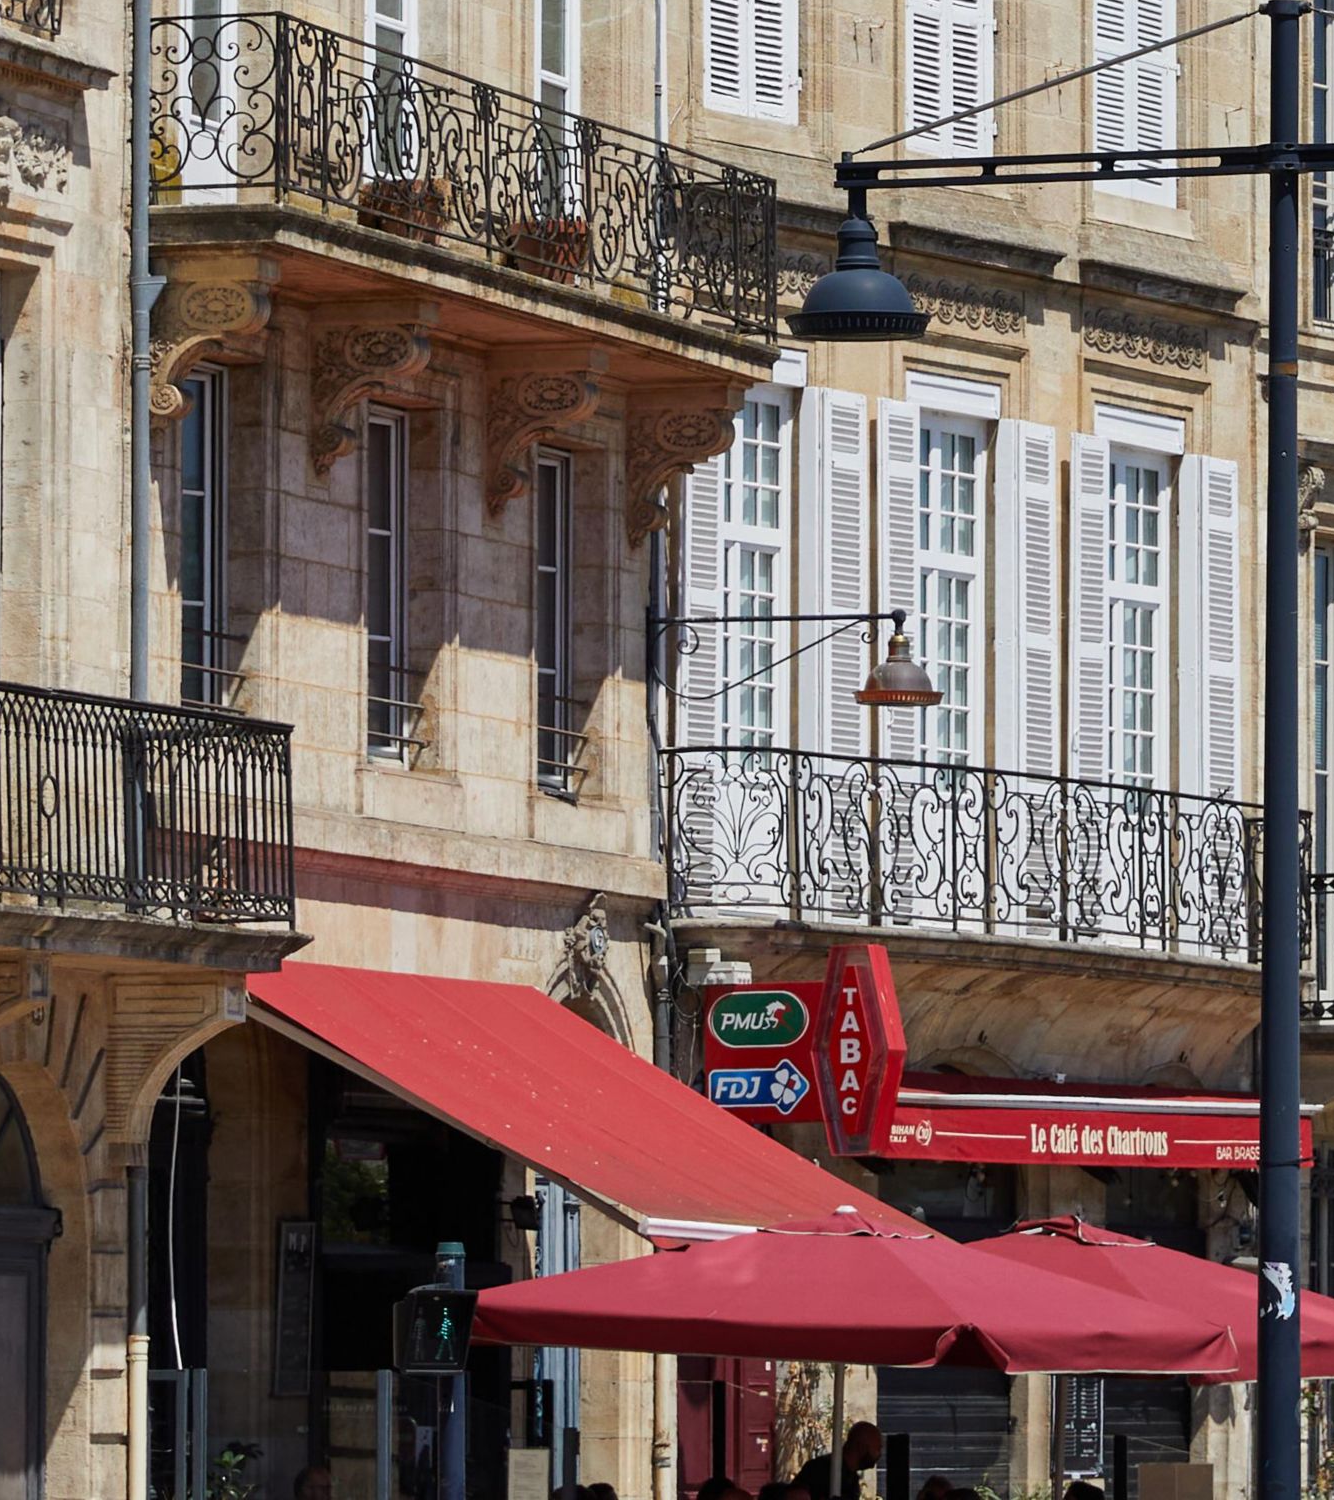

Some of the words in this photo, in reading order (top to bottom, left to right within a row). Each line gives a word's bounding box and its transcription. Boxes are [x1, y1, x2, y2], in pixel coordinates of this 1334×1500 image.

[720, 1012, 765, 1031] PMU
[839, 987, 862, 1115] TABAC
[715, 1076, 761, 1100] FDJ
[891, 1124, 916, 1136] BIHAN
[1030, 1123, 1047, 1154] Le
[1050, 1122, 1079, 1155] Café
[1081, 1124, 1104, 1155] des
[1107, 1125, 1169, 1156] Chartrons
[1216, 1146, 1233, 1161] BAR
